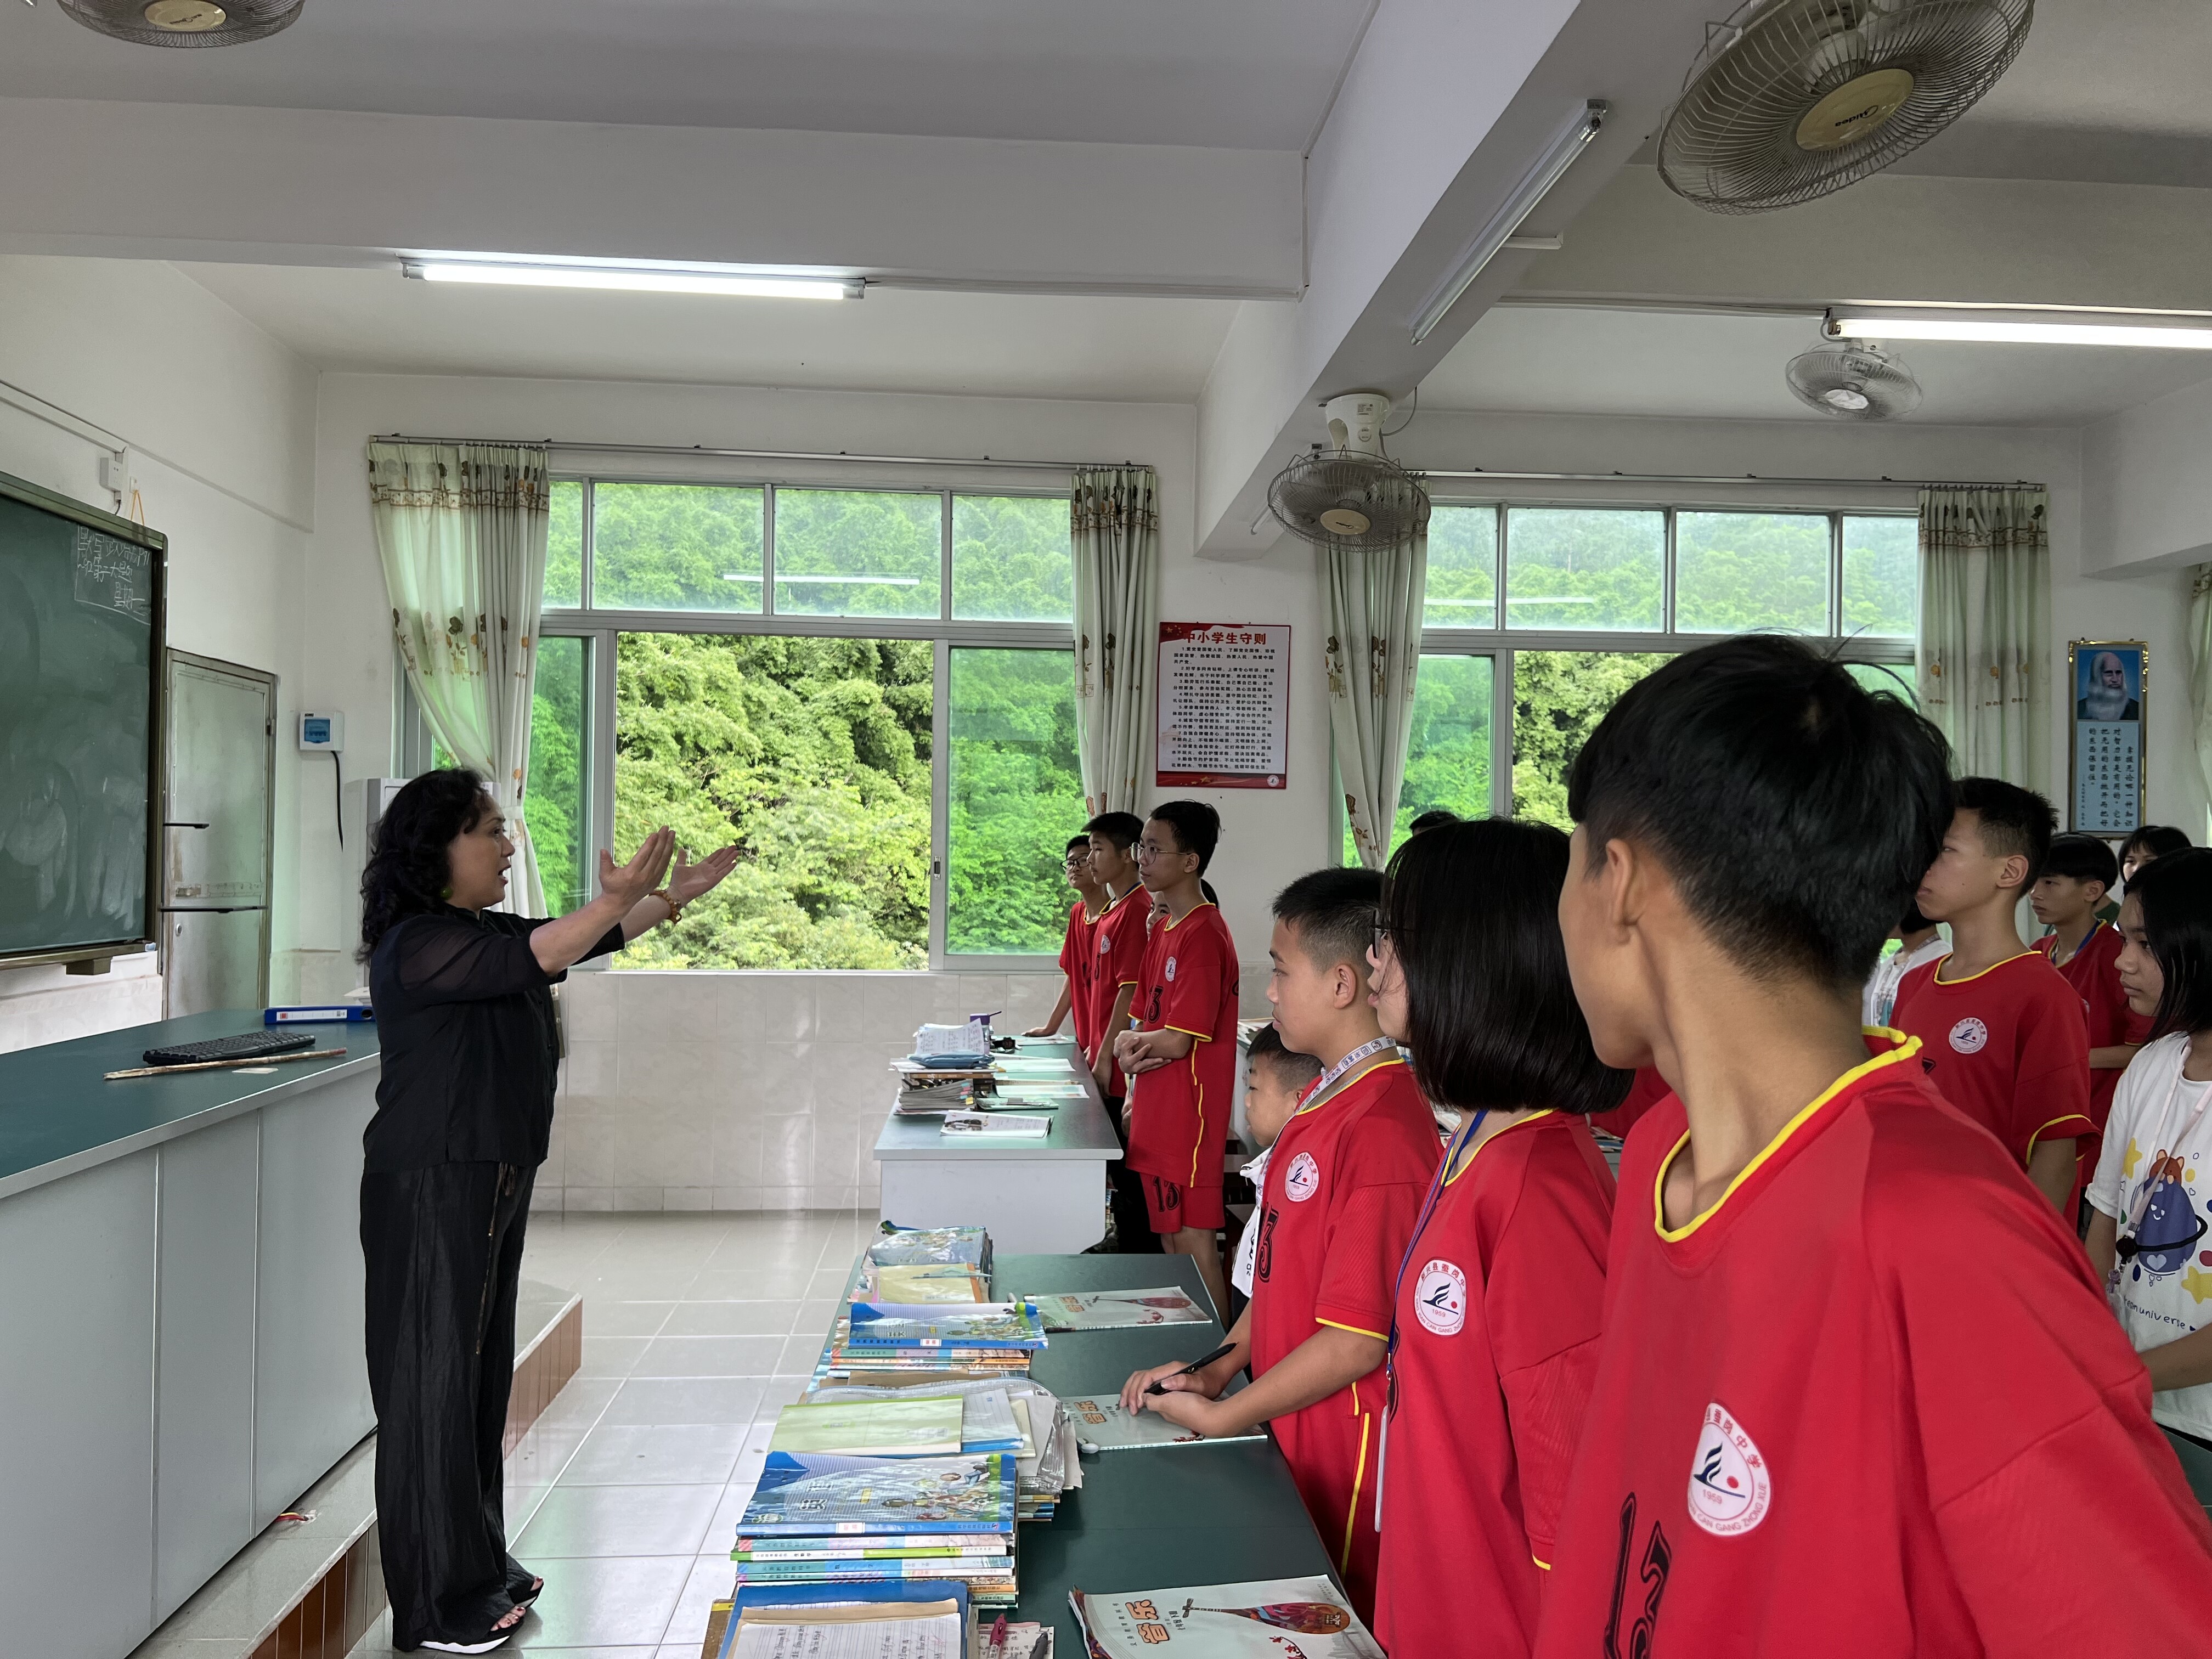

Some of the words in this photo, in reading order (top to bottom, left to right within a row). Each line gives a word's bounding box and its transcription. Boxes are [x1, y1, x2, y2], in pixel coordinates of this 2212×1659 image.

[1835, 105, 1878, 127] Midea
[1183, 632, 1266, 645] 中小学生守则
[1432, 1308, 1446, 1317] 1959
[2139, 1307, 2186, 1329] universe
[1426, 1322, 1437, 1330] CAN
[1075, 1400, 1107, 1424] 音乐
[1697, 1513, 1713, 1528] CAN
[1716, 1522, 1742, 1531] GANG
[1743, 1503, 1764, 1527] ZHONG
[1758, 1482, 1767, 1502] XUE
[1125, 1599, 1170, 1645] 音乐
